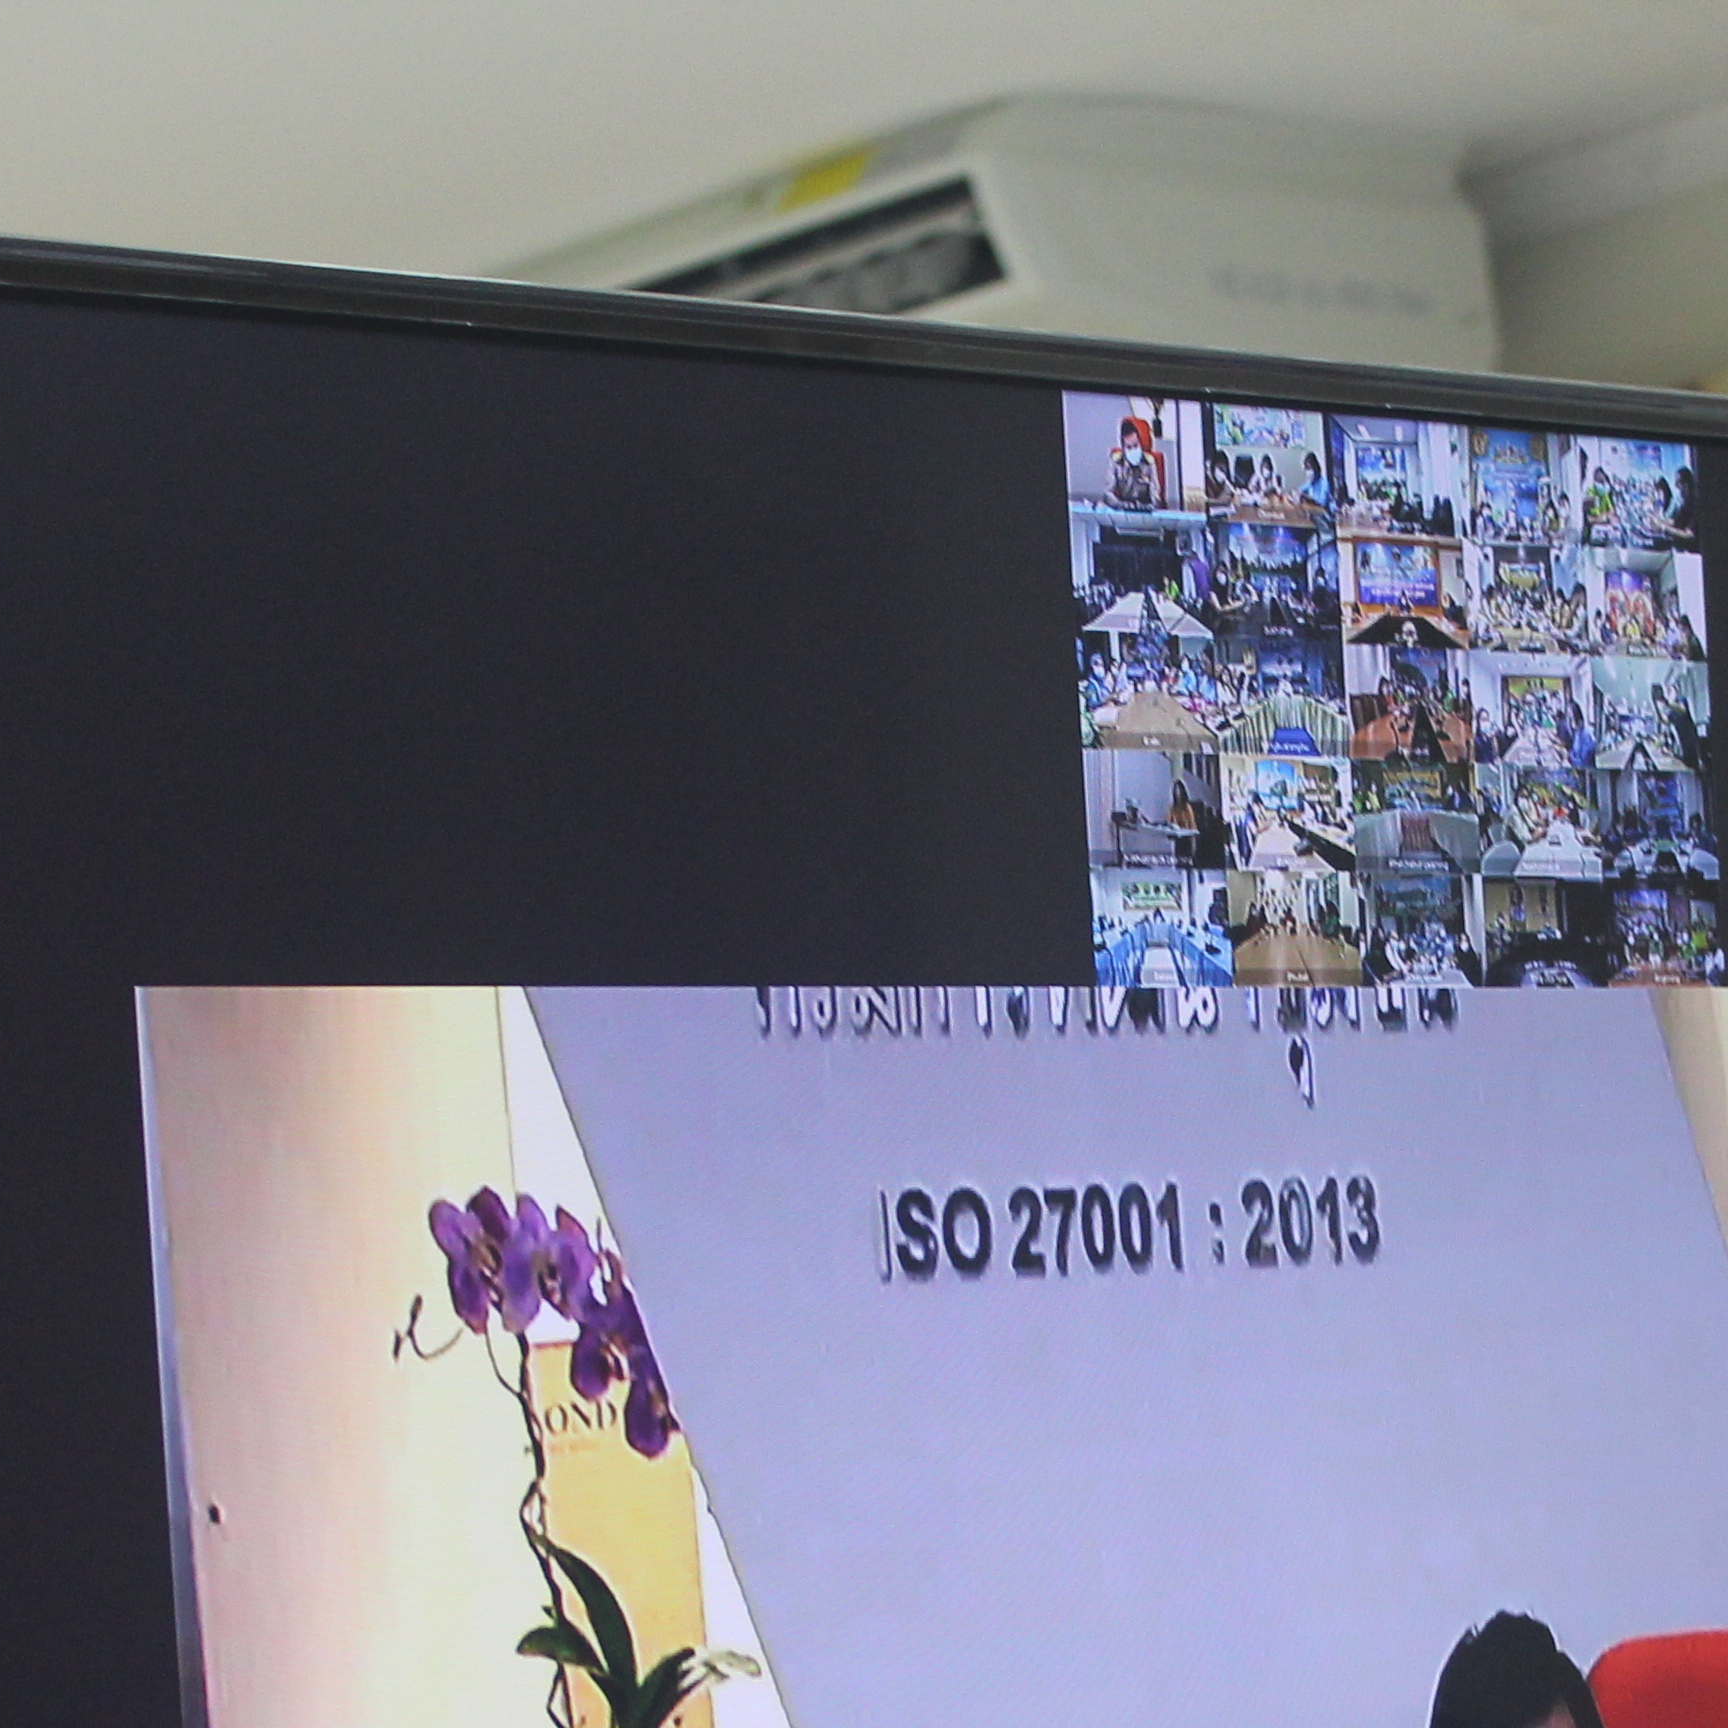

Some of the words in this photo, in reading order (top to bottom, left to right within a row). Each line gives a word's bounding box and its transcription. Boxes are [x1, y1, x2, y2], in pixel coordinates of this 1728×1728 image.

[880, 1184, 993, 1283] ISO
[1007, 1180, 1184, 1278] 27001
[1209, 1202, 1225, 1265] :
[1240, 1176, 1380, 1269] 2013
